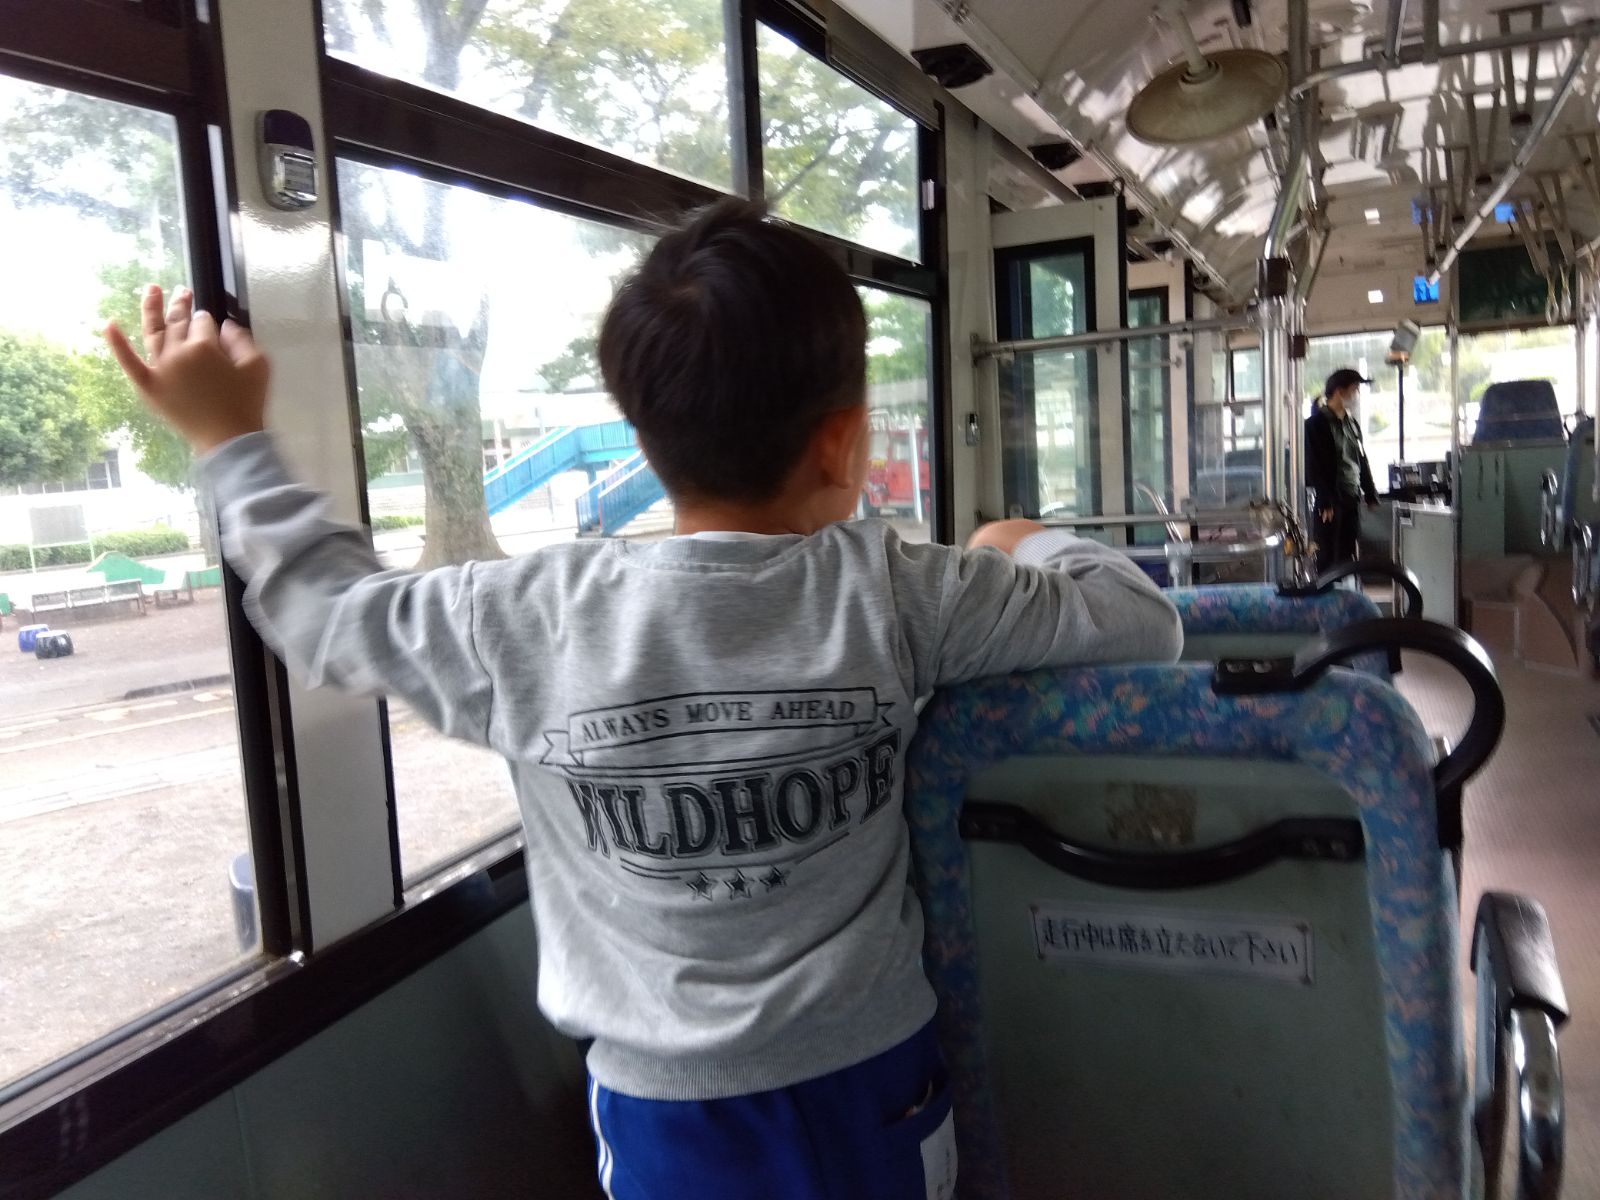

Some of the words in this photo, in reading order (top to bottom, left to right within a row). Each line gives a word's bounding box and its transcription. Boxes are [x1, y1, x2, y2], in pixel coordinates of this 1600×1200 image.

[581, 708, 671, 743] ALWAYS
[685, 701, 752, 724] MOVE
[769, 700, 855, 721] AHEAD
[564, 728, 901, 859] WILDHOPE
